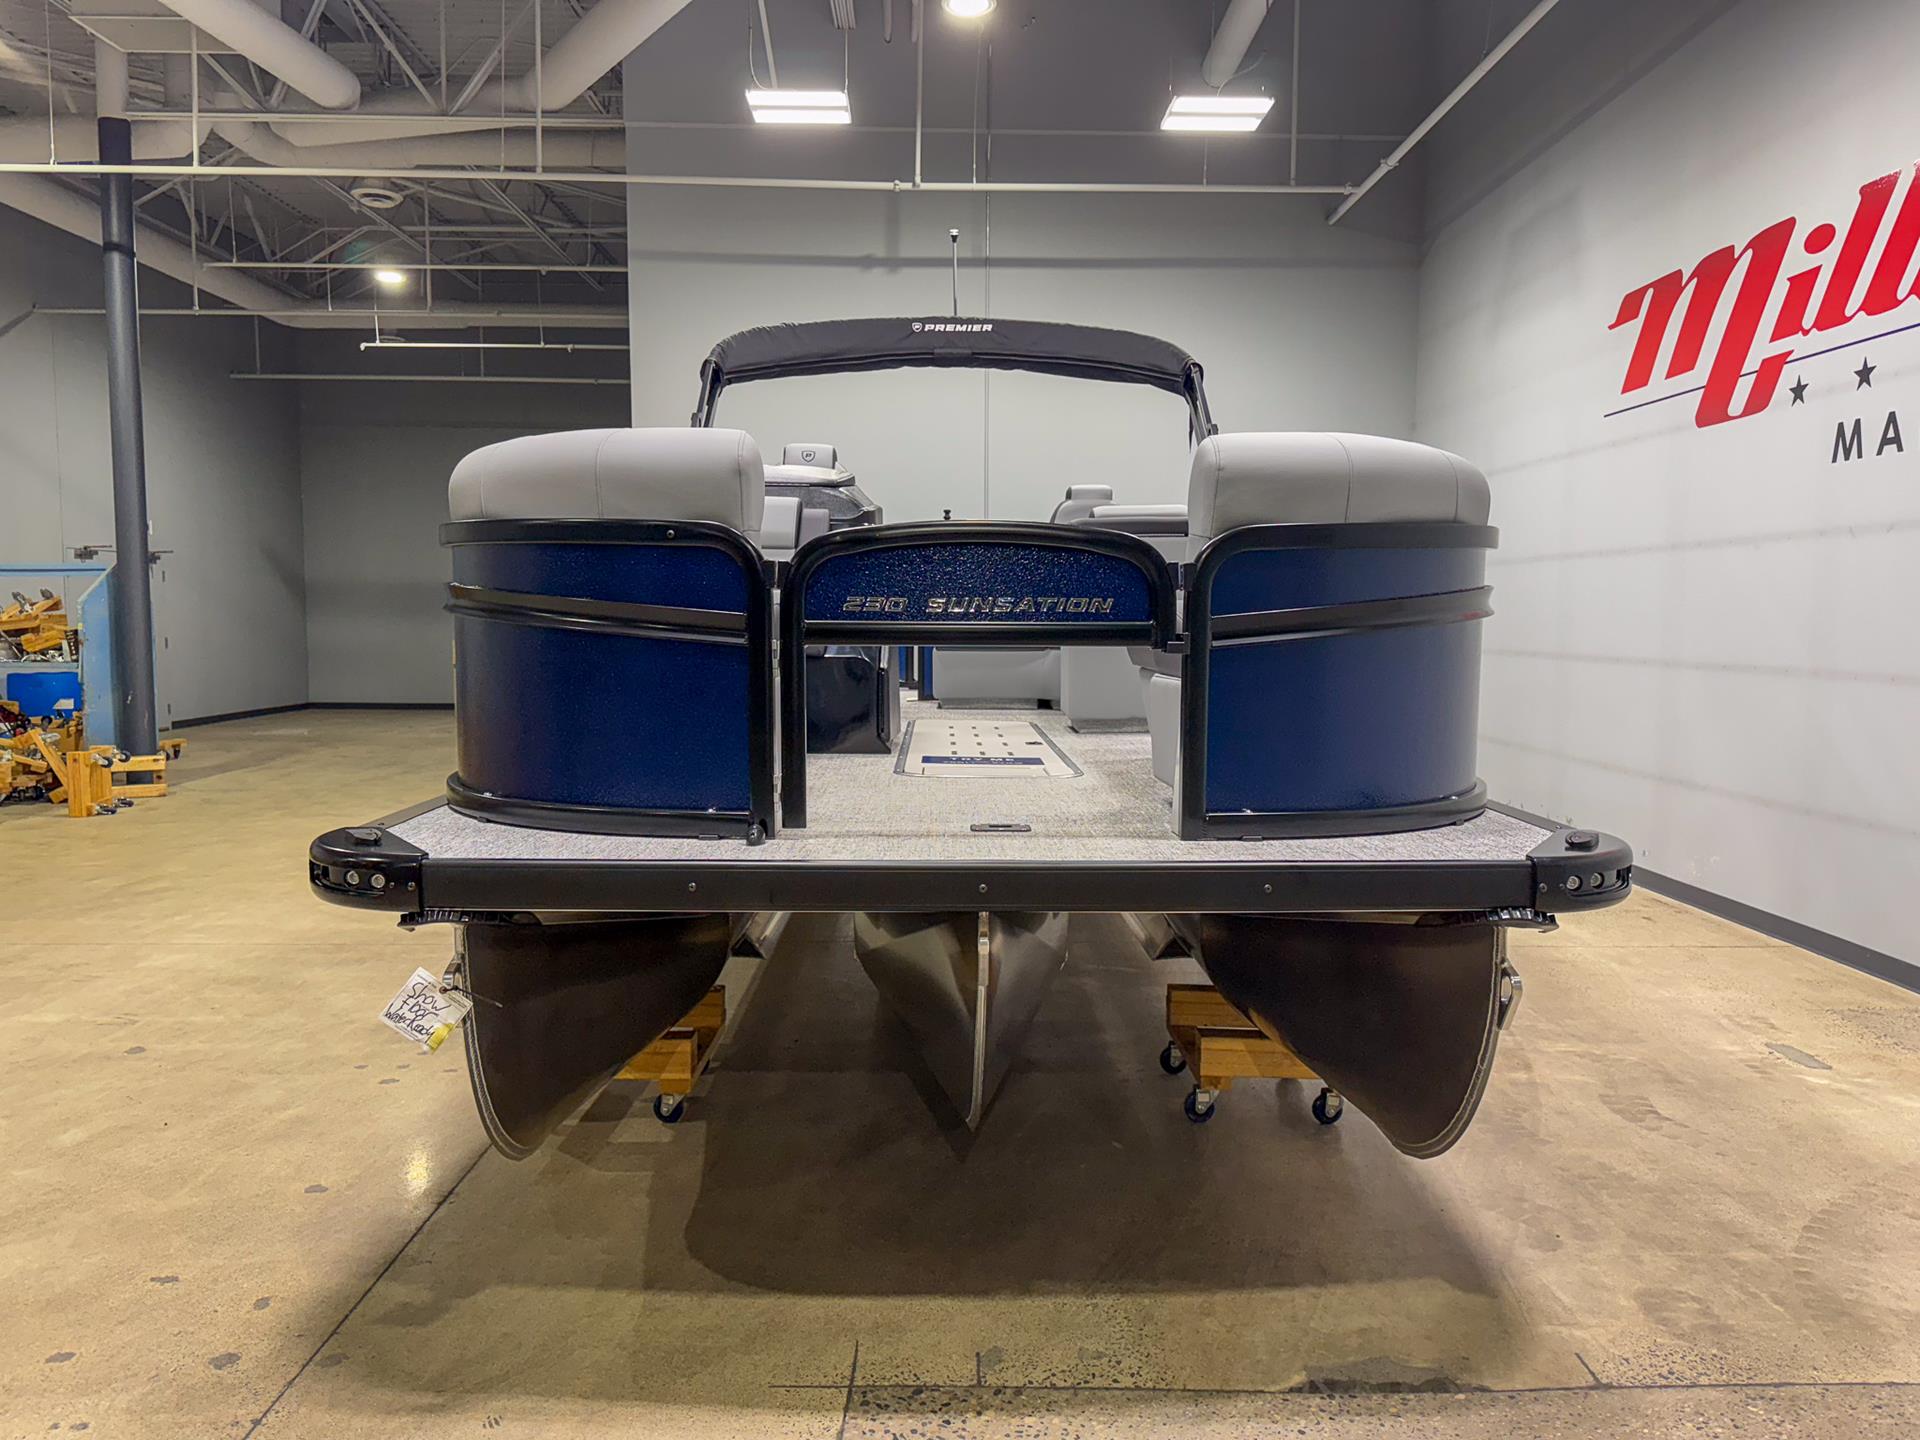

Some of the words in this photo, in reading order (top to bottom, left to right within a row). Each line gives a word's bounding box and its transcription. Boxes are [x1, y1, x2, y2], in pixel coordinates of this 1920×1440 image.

[1608, 158, 1920, 428] Mill
[924, 323, 993, 332] PREMIER
[842, 596, 908, 612] 230
[925, 596, 1114, 613] SUNSATION
[407, 982, 452, 1012] Show
